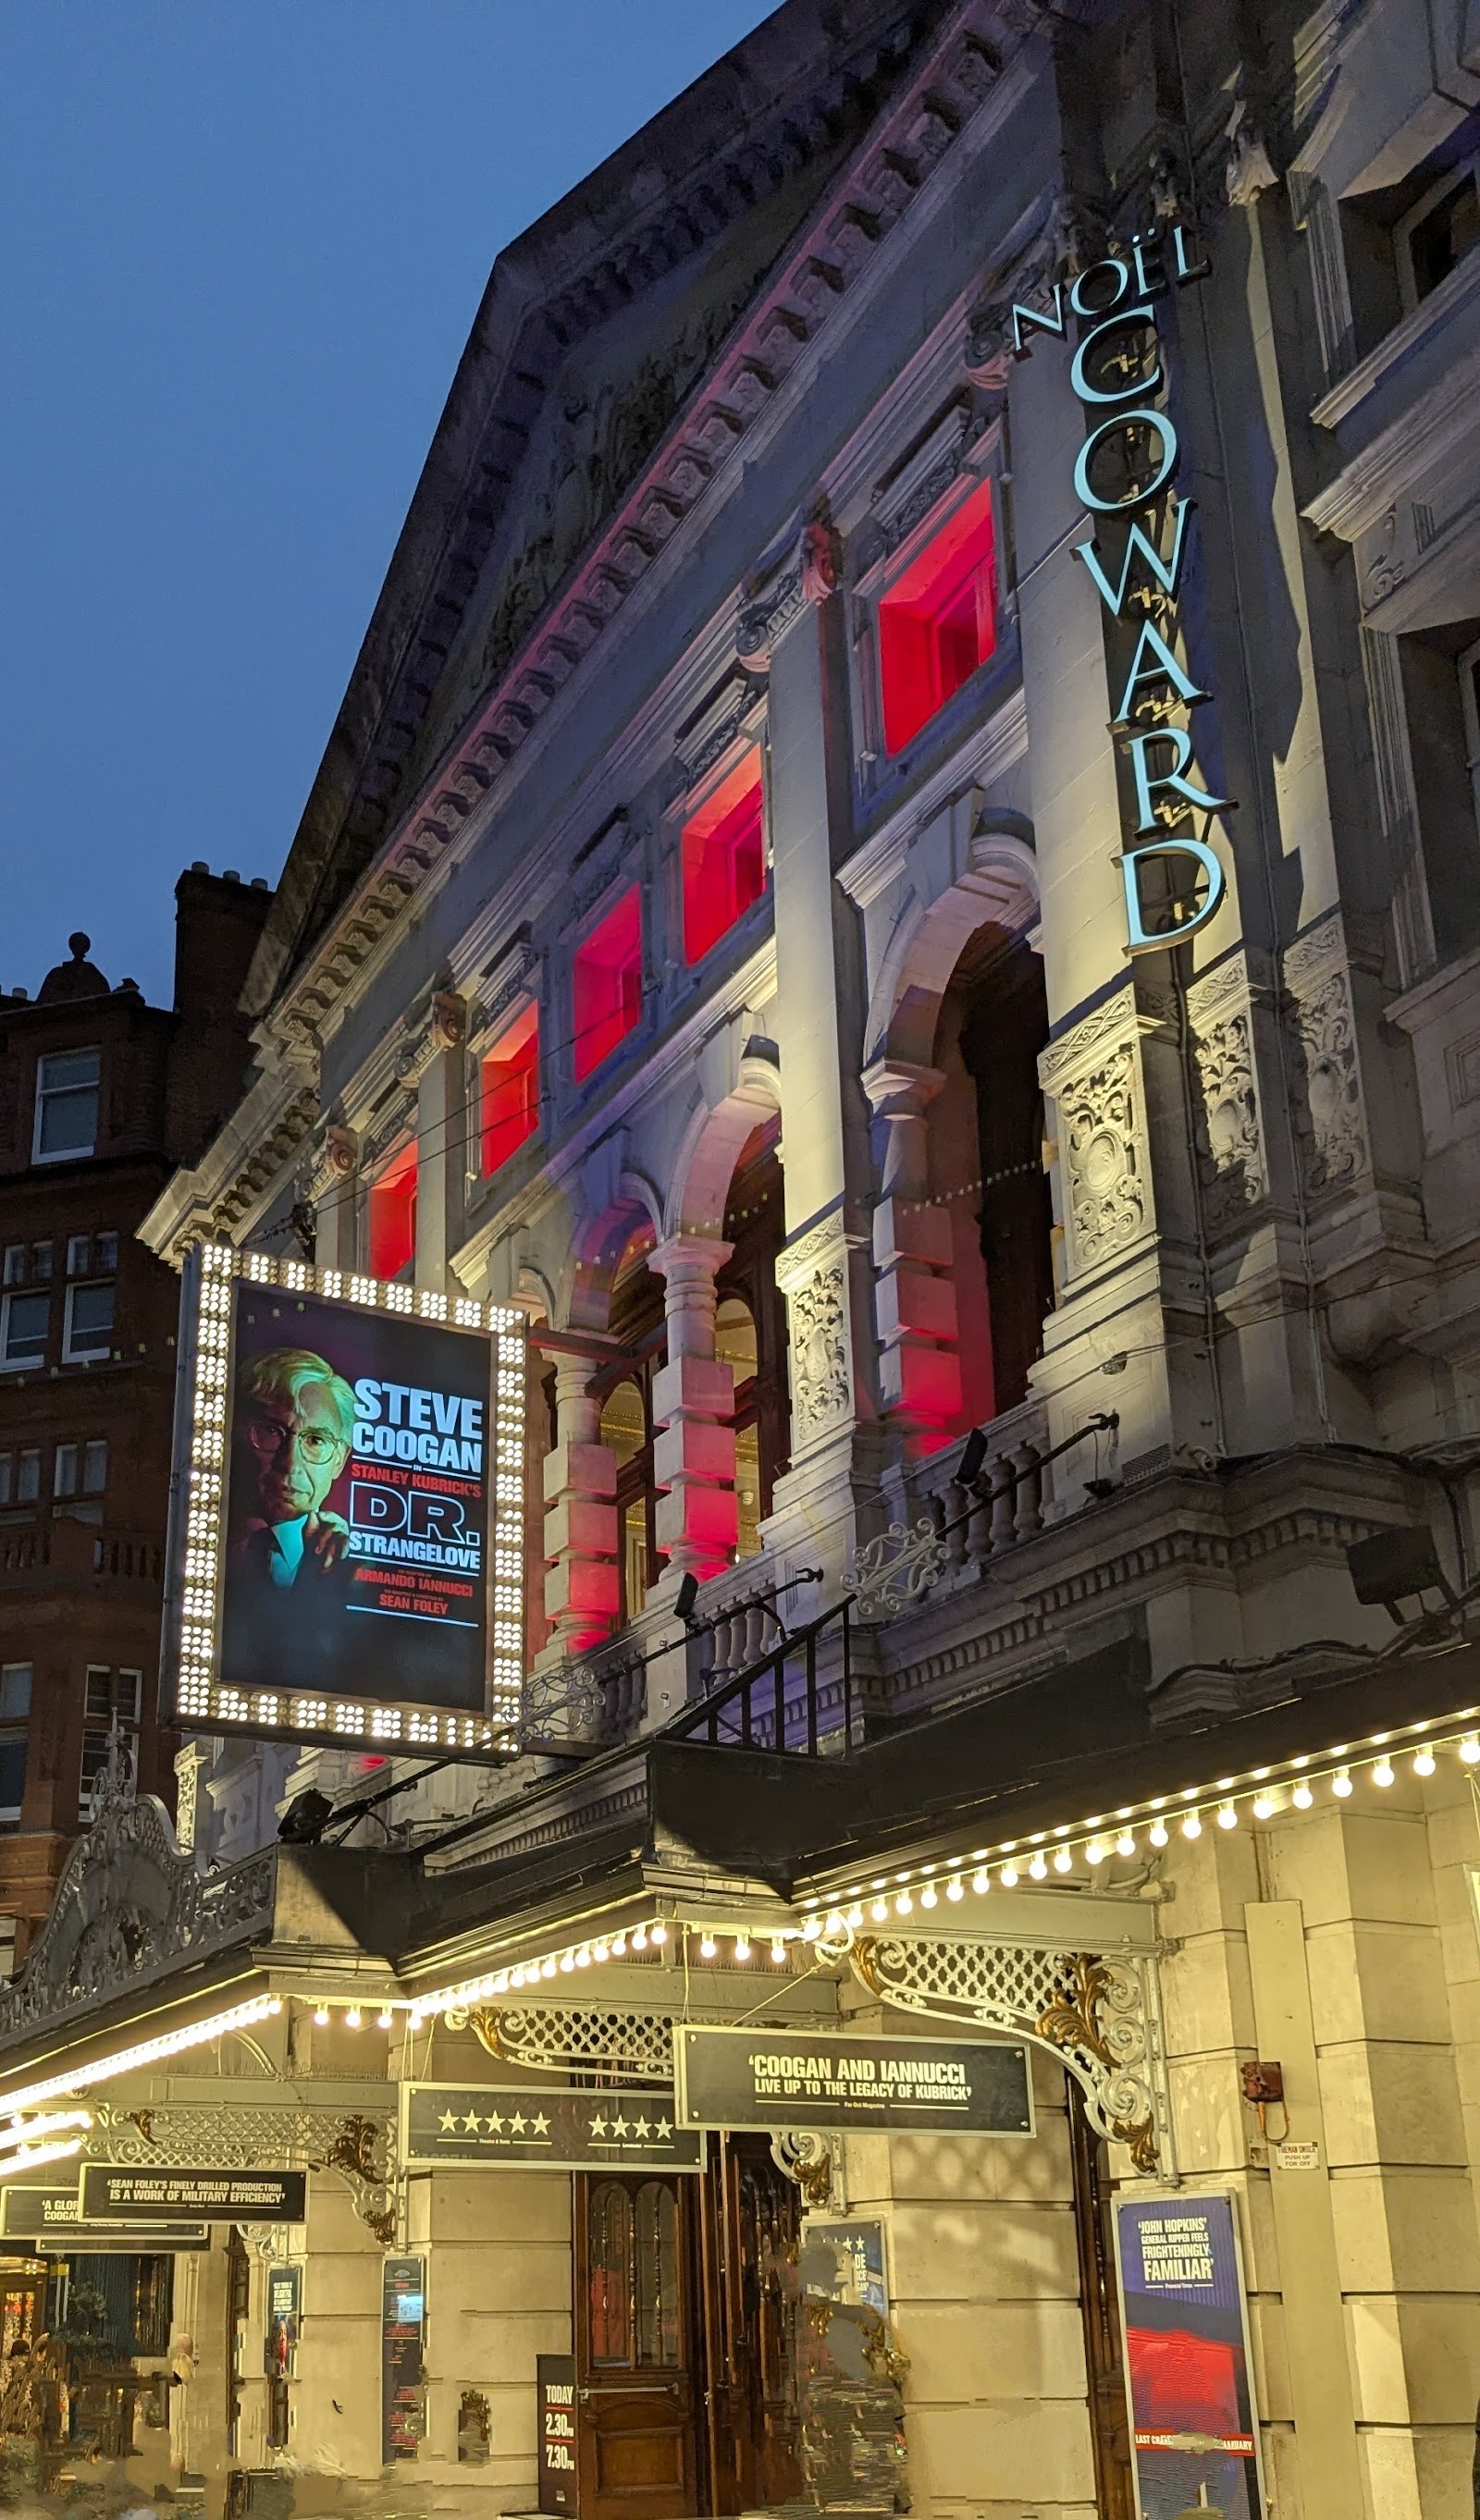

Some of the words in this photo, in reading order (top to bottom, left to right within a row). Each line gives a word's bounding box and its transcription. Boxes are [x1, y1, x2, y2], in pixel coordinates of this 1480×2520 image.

[1011, 226, 1208, 355] NOËL
[1070, 305, 1238, 955] COWARD
[353, 1378, 483, 1440] STEVE
[352, 1421, 482, 1473] COOGAN
[352, 1463, 410, 1488] STANLEY
[412, 1473, 481, 1498] KUBRICK'S
[350, 1481, 480, 1547] DR.
[349, 1531, 480, 1570] STRANGELOVE
[355, 1568, 415, 1588] ARMANDO
[418, 1578, 473, 1597] IANNUCCI
[379, 1594, 410, 1610] SEAN
[413, 1599, 449, 1615] FOLEY
[836, 2059, 875, 2081] AND
[881, 2060, 966, 2084] IANNUCCI
[755, 2078, 781, 2094] LIVE
[784, 2080, 801, 2095] UP
[804, 2080, 821, 2095] TO
[823, 2081, 847, 2096] THE
[849, 2082, 894, 2097] LEGACY
[897, 2084, 913, 2098] OF
[110, 2189, 120, 2200] IS
[122, 2190, 130, 2200] A
[133, 2190, 165, 2201] WORK
[166, 2190, 179, 2201] OF
[181, 2191, 228, 2202] MILITARY
[135, 2180, 167, 2190] FOLEY'S
[169, 2181, 196, 2191] FINELY
[197, 2181, 229, 2192] DRILLED
[231, 2182, 282, 2193] PRODUCTION
[1141, 2234, 1167, 2244] GENERAL
[1167, 2233, 1190, 2243] RIPPER
[1190, 2232, 1209, 2243] FEELS
[1141, 2243, 1210, 2259] FRIGHTENINGLY
[546, 2385, 574, 2404] TODAY
[1135, 2434, 1151, 2444] LAST
